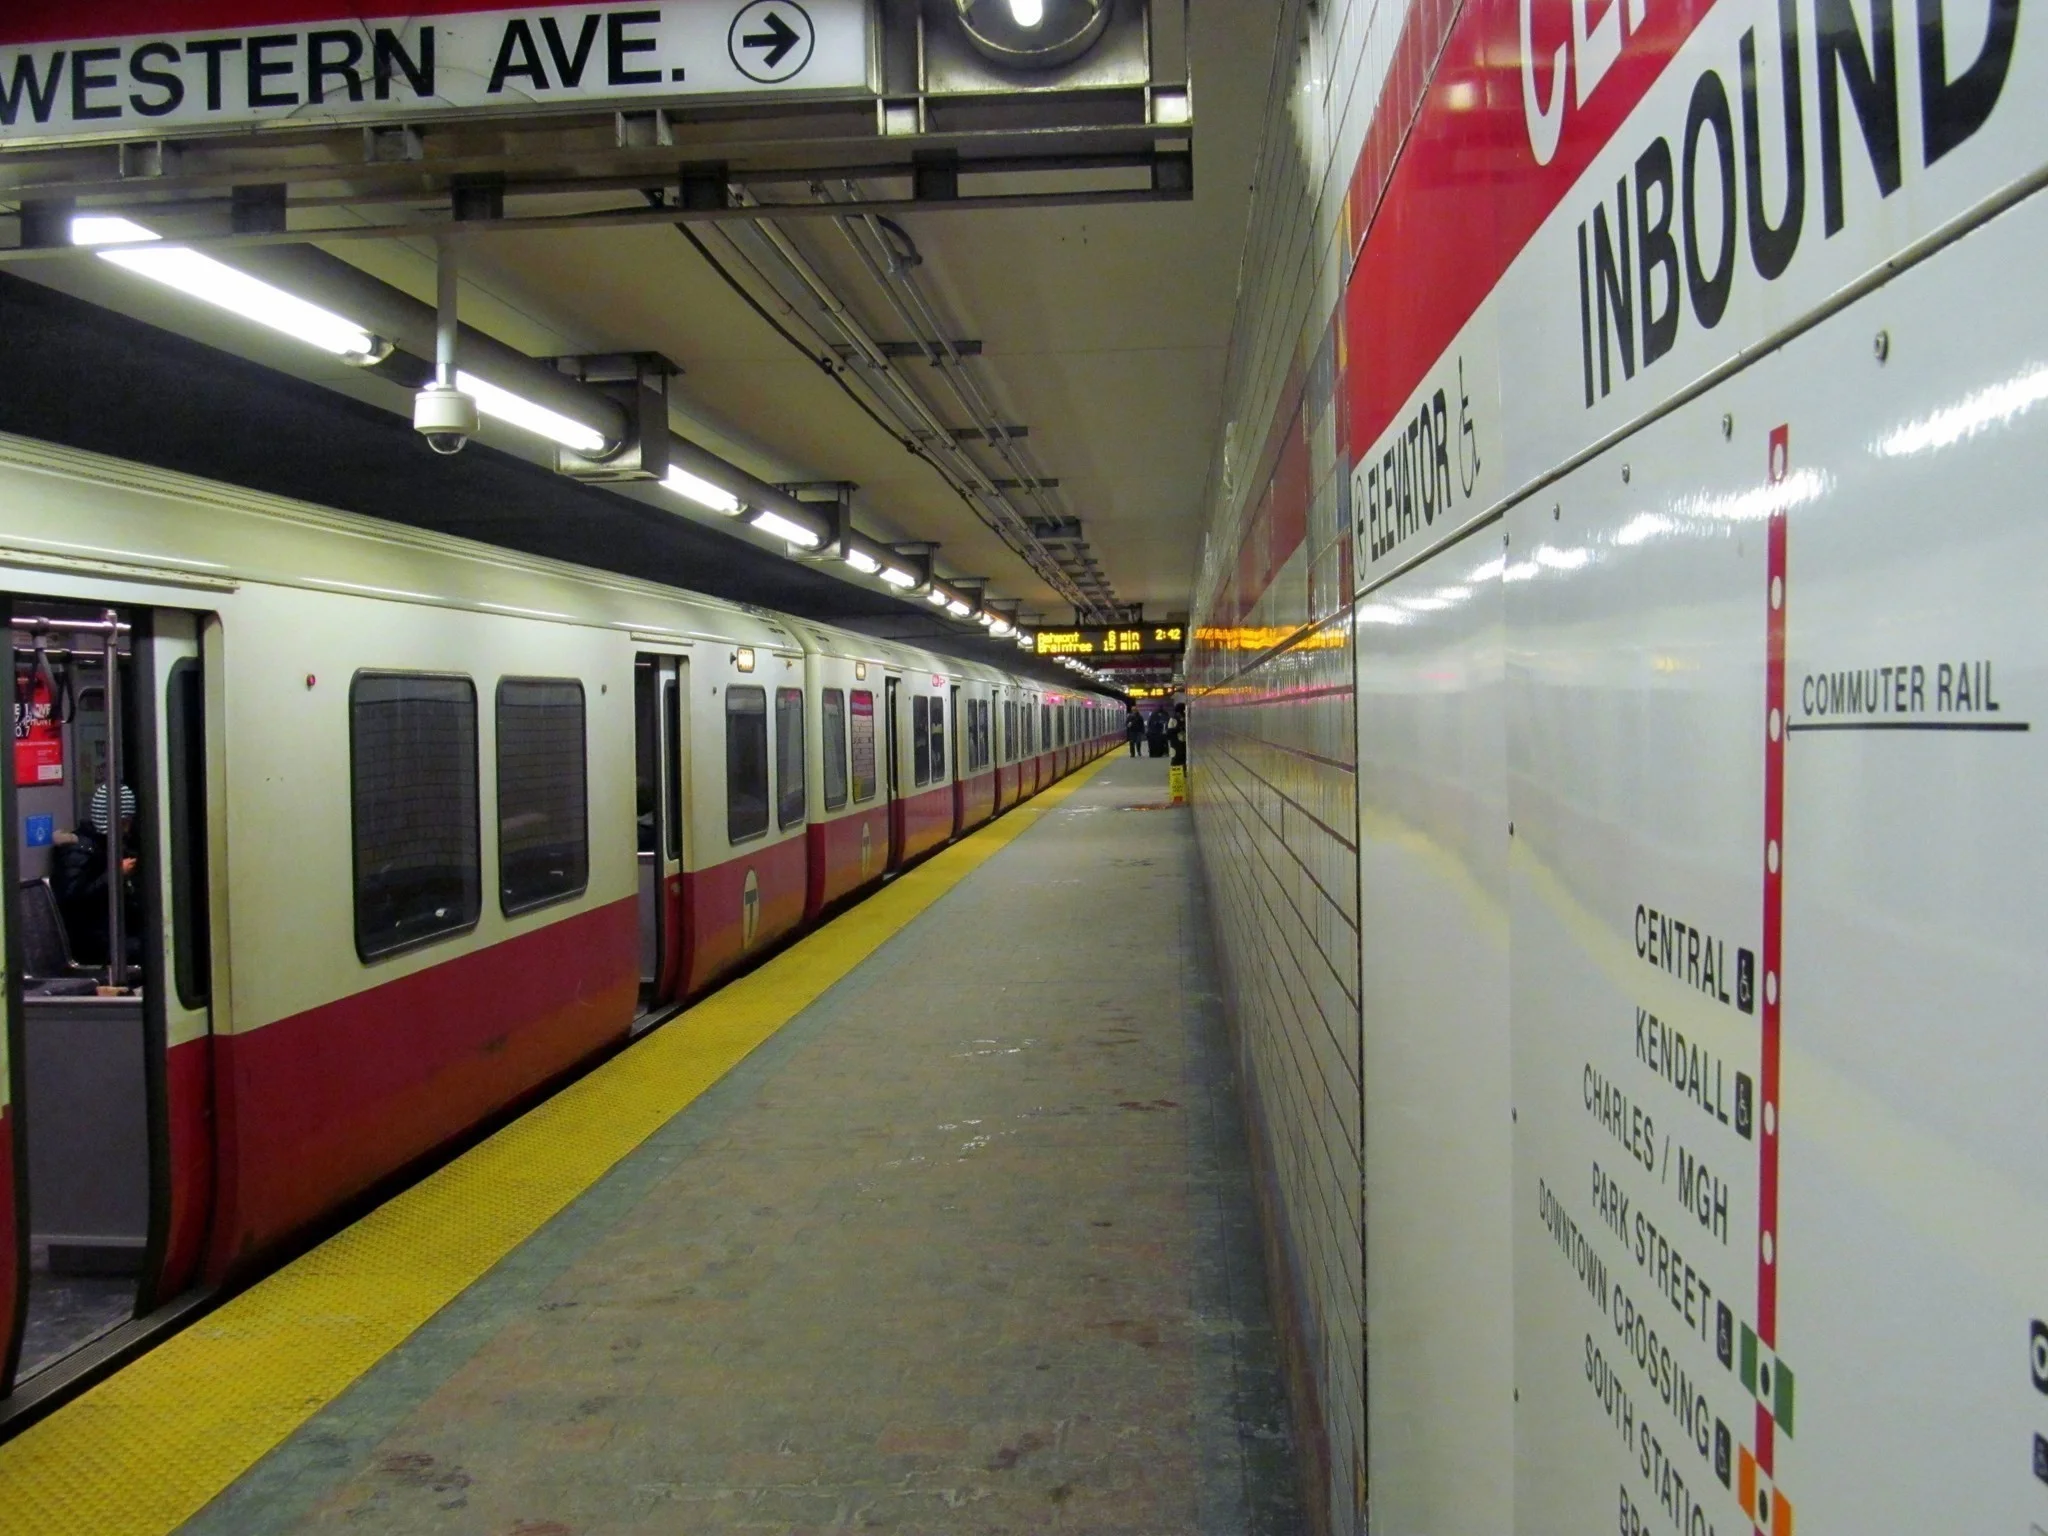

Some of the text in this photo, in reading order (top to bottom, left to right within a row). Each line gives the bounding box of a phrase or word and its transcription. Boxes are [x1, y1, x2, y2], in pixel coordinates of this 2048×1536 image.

[0, 10, 686, 125] WESTERN AVE.
[1367, 387, 1452, 562] ELEVATOR
[1037, 632, 1079, 643] Ashmont
[1119, 630, 1140, 641] min
[1155, 628, 1180, 640] 2:42
[1037, 640, 1140, 653] Braintree 15 min
[1802, 660, 1999, 716] COMMUTER RAIL
[1635, 904, 1730, 1005] CENTRAL
[1636, 1006, 1729, 1126] KENDALL
[1583, 1063, 1728, 1245] CHARLES / MGH
[1592, 1160, 1711, 1342] PARK STREET
[1539, 1177, 1710, 1462] DOWNTOWN CROSSING
[1585, 1333, 1715, 1536] SOUTH STATIO
[1619, 1483, 1650, 1536] BR
